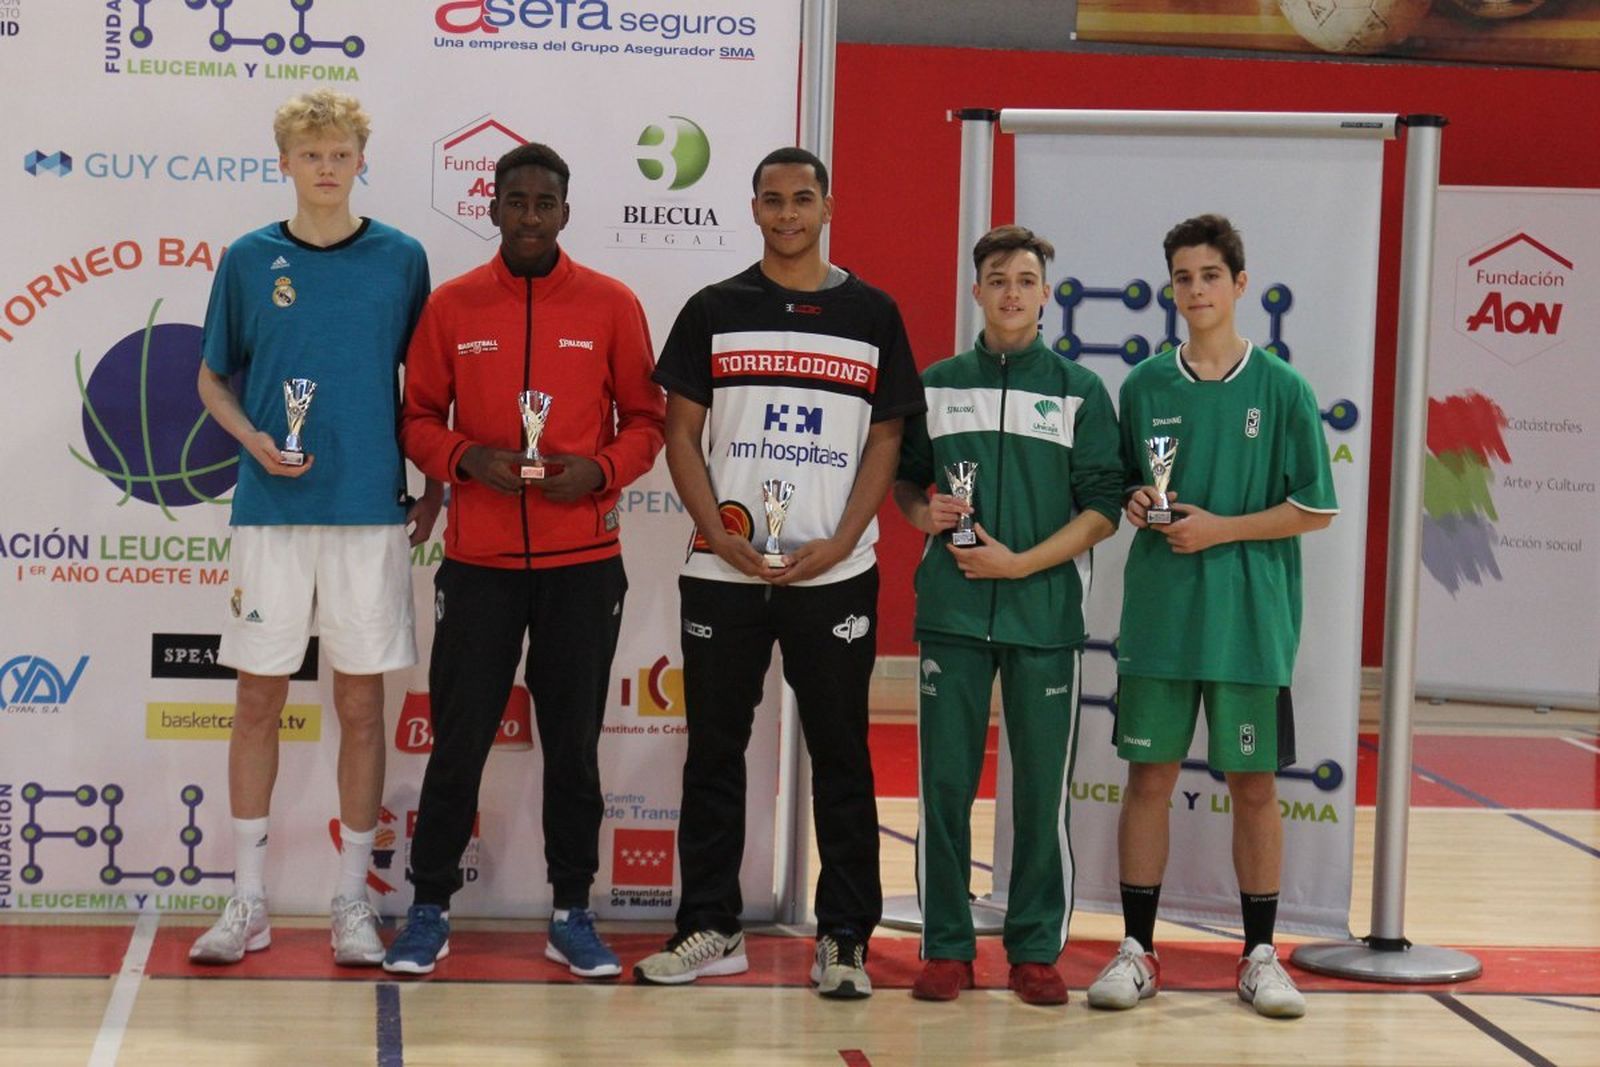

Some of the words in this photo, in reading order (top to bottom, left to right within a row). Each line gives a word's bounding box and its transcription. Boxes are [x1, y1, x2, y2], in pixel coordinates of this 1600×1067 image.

[619, 12, 757, 40] seguros
[434, 36, 464, 49] Una
[469, 39, 538, 53] empresa
[543, 40, 567, 52] del
[571, 41, 619, 55] Grupo
[623, 43, 715, 57] Asegurador
[719, 46, 756, 59] SMA
[126, 59, 237, 78] LEUCEMIA
[244, 63, 258, 78] Y
[264, 64, 360, 82] LINFOMA
[85, 153, 160, 181] GUY
[623, 205, 719, 227] BLECUA
[158, 237, 228, 273] BA
[1476, 269, 1565, 287] Fundación
[558, 338, 593, 351] SPALDING
[1152, 415, 1182, 427] SPALDING
[760, 437, 849, 468] hospitaes
[1503, 475, 1532, 490] Arte
[1535, 480, 1544, 494] y
[1547, 478, 1596, 493] Cultura
[1500, 535, 1543, 550] Acción
[1545, 539, 1583, 553] social
[51, 562, 99, 583] AÑO
[106, 566, 191, 585] CADETE
[164, 648, 219, 664] SPEA
[601, 724, 645, 735] Instituto
[647, 725, 660, 735] de
[1184, 790, 1201, 811] Y
[18, 893, 128, 910] LEUCEMIA
[134, 894, 148, 909] Y
[611, 888, 673, 898] Comunidad
[611, 898, 627, 908] de
[630, 898, 673, 908] Madrid
